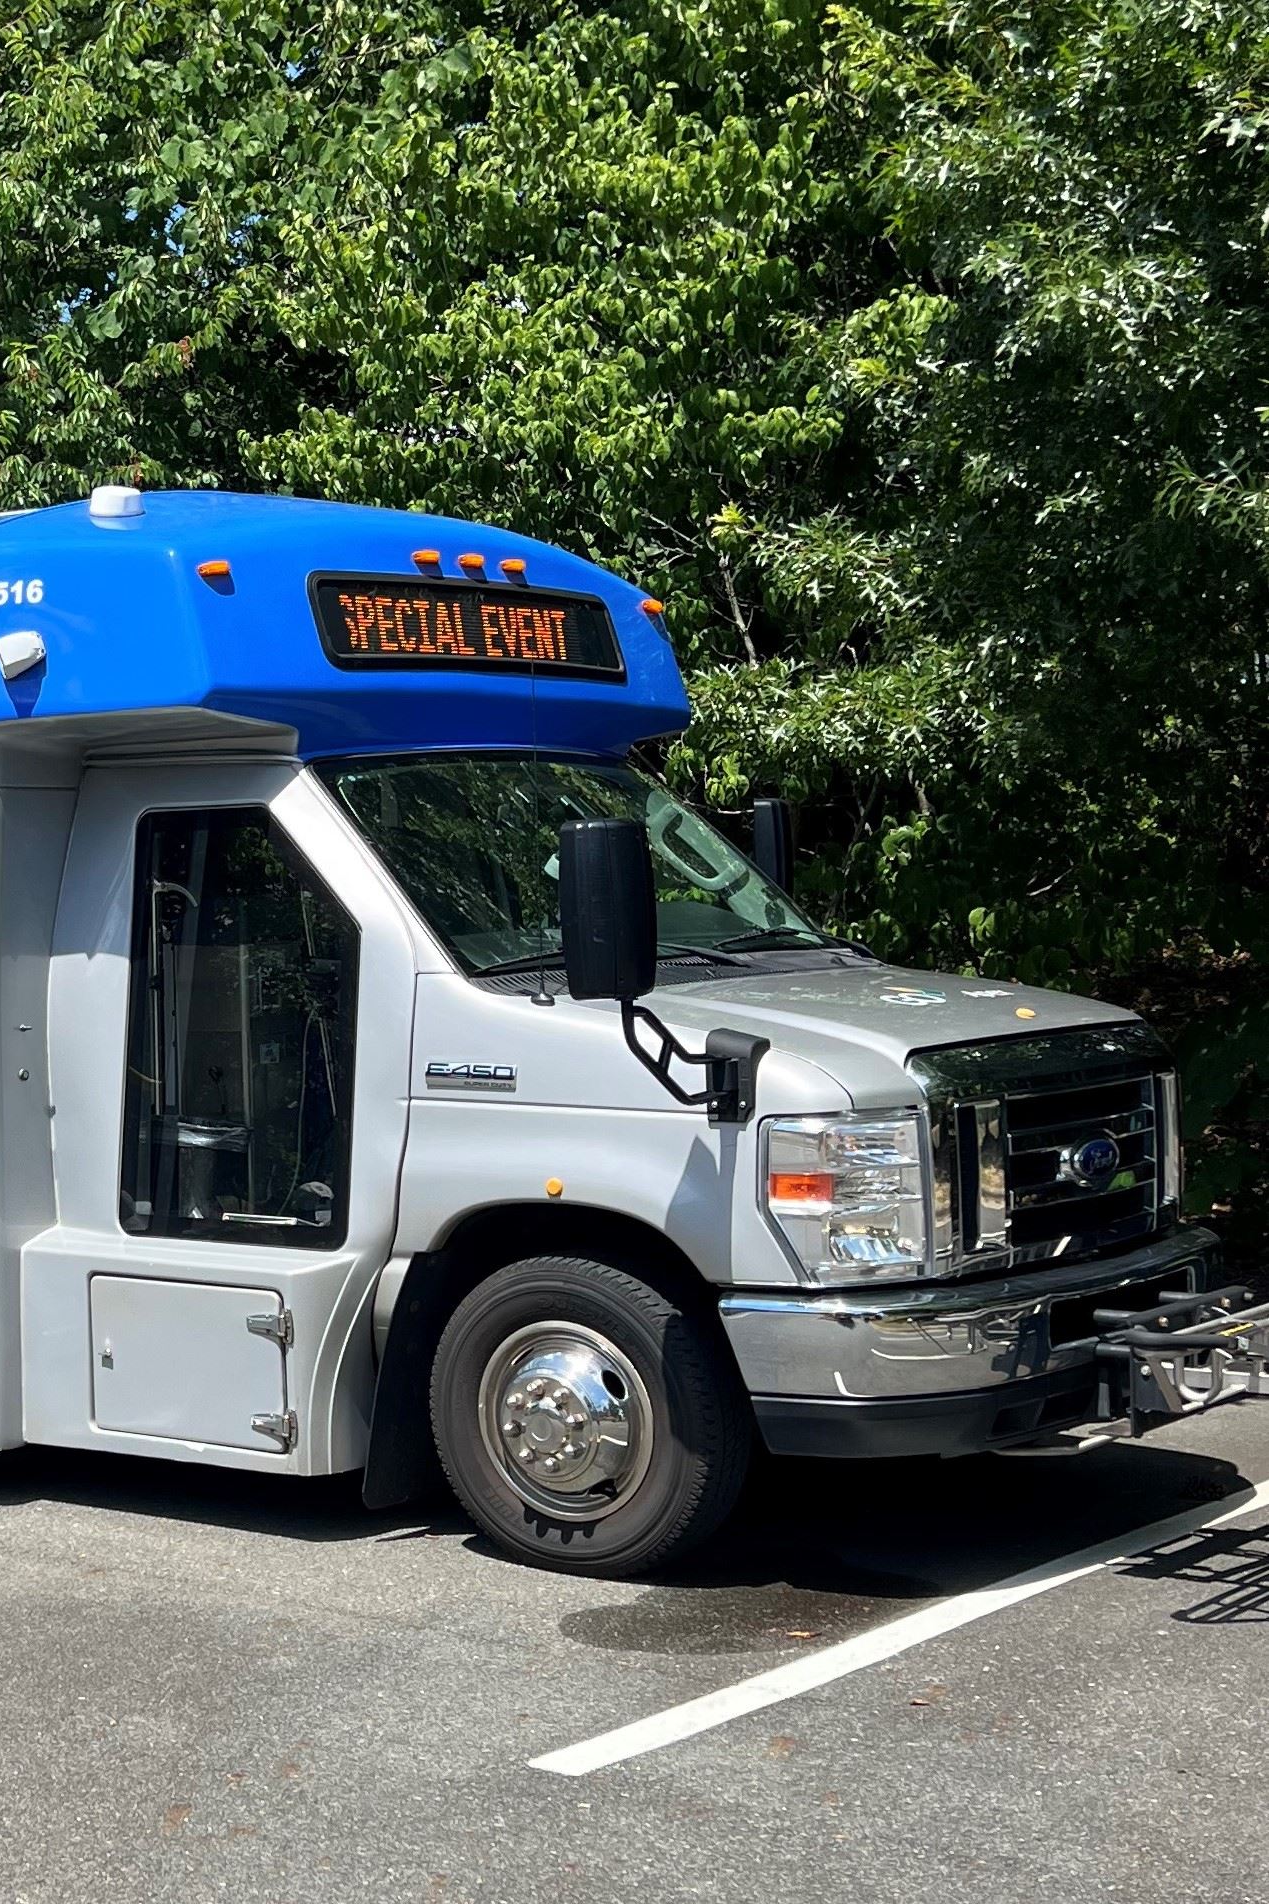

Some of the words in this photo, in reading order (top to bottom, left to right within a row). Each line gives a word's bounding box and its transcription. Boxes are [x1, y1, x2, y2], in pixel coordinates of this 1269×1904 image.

[338, 594, 476, 656] SPECIAL
[480, 604, 567, 660] EVENT
[425, 1062, 515, 1080] E-450
